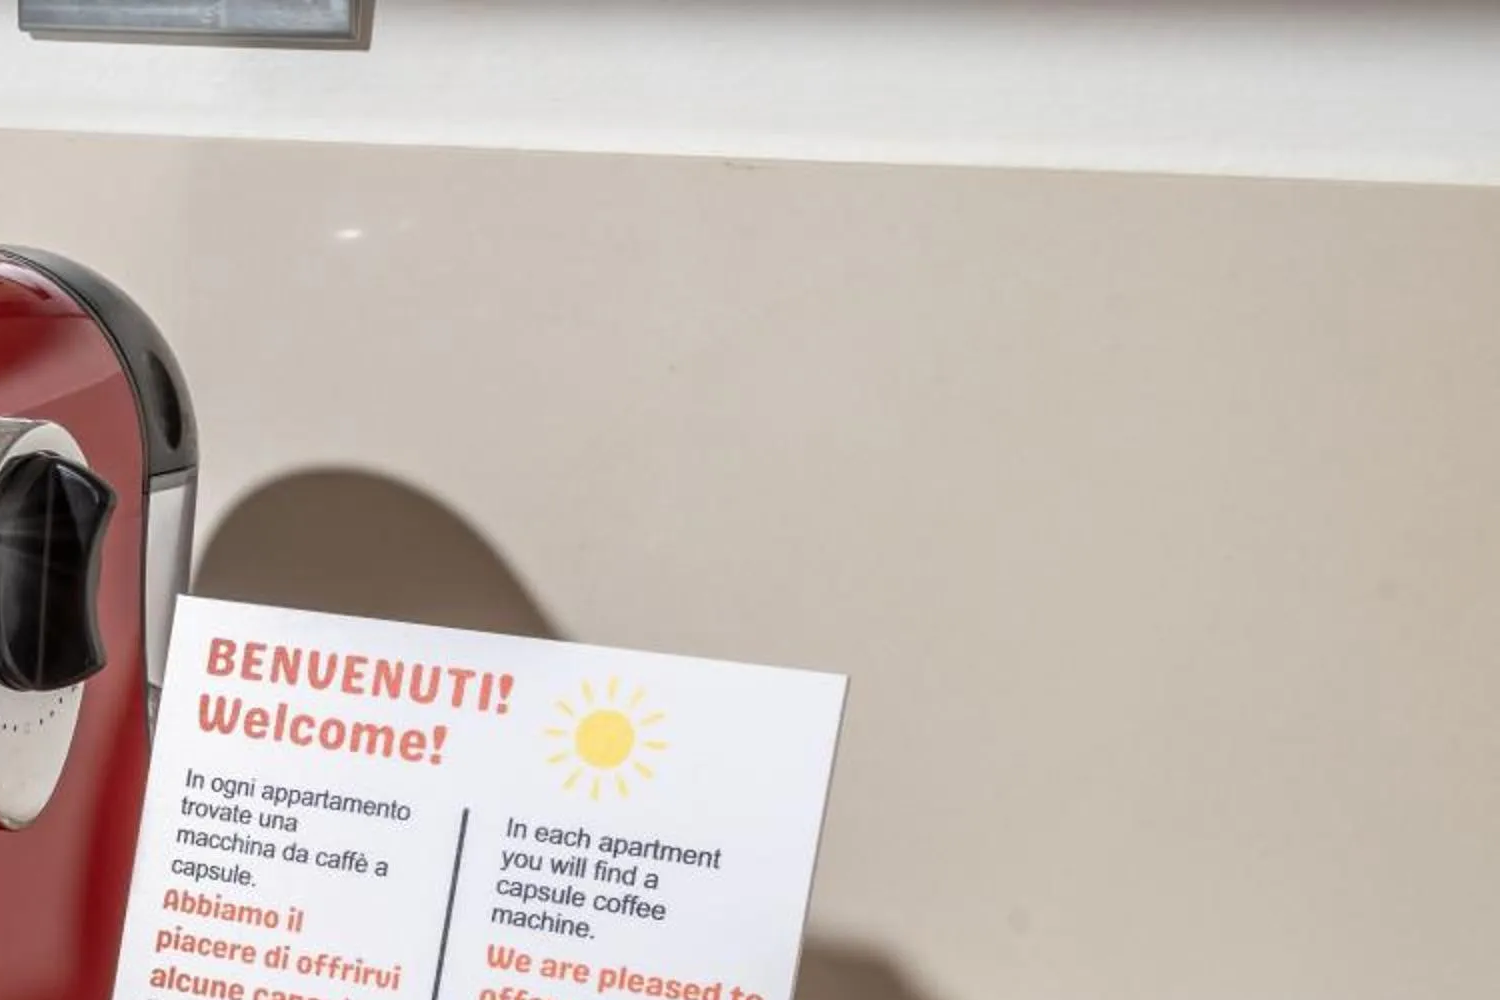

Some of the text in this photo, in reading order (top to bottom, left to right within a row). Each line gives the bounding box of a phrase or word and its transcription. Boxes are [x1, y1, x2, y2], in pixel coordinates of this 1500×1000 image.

[198, 692, 448, 766] Welcome!
[180, 795, 300, 833] trovate una
[184, 767, 412, 822] In ogni appartamento
[175, 828, 389, 878] macchina da caffè a
[505, 816, 722, 870] In each apartment
[170, 858, 257, 888] capsule.
[499, 849, 660, 891] you will find a
[162, 888, 305, 933] Abbiamo il
[495, 878, 667, 921] capsule coffee
[490, 907, 596, 940] machine.
[155, 925, 402, 991] piacere di offrirvi
[486, 943, 533, 974] We
[539, 958, 591, 985] are
